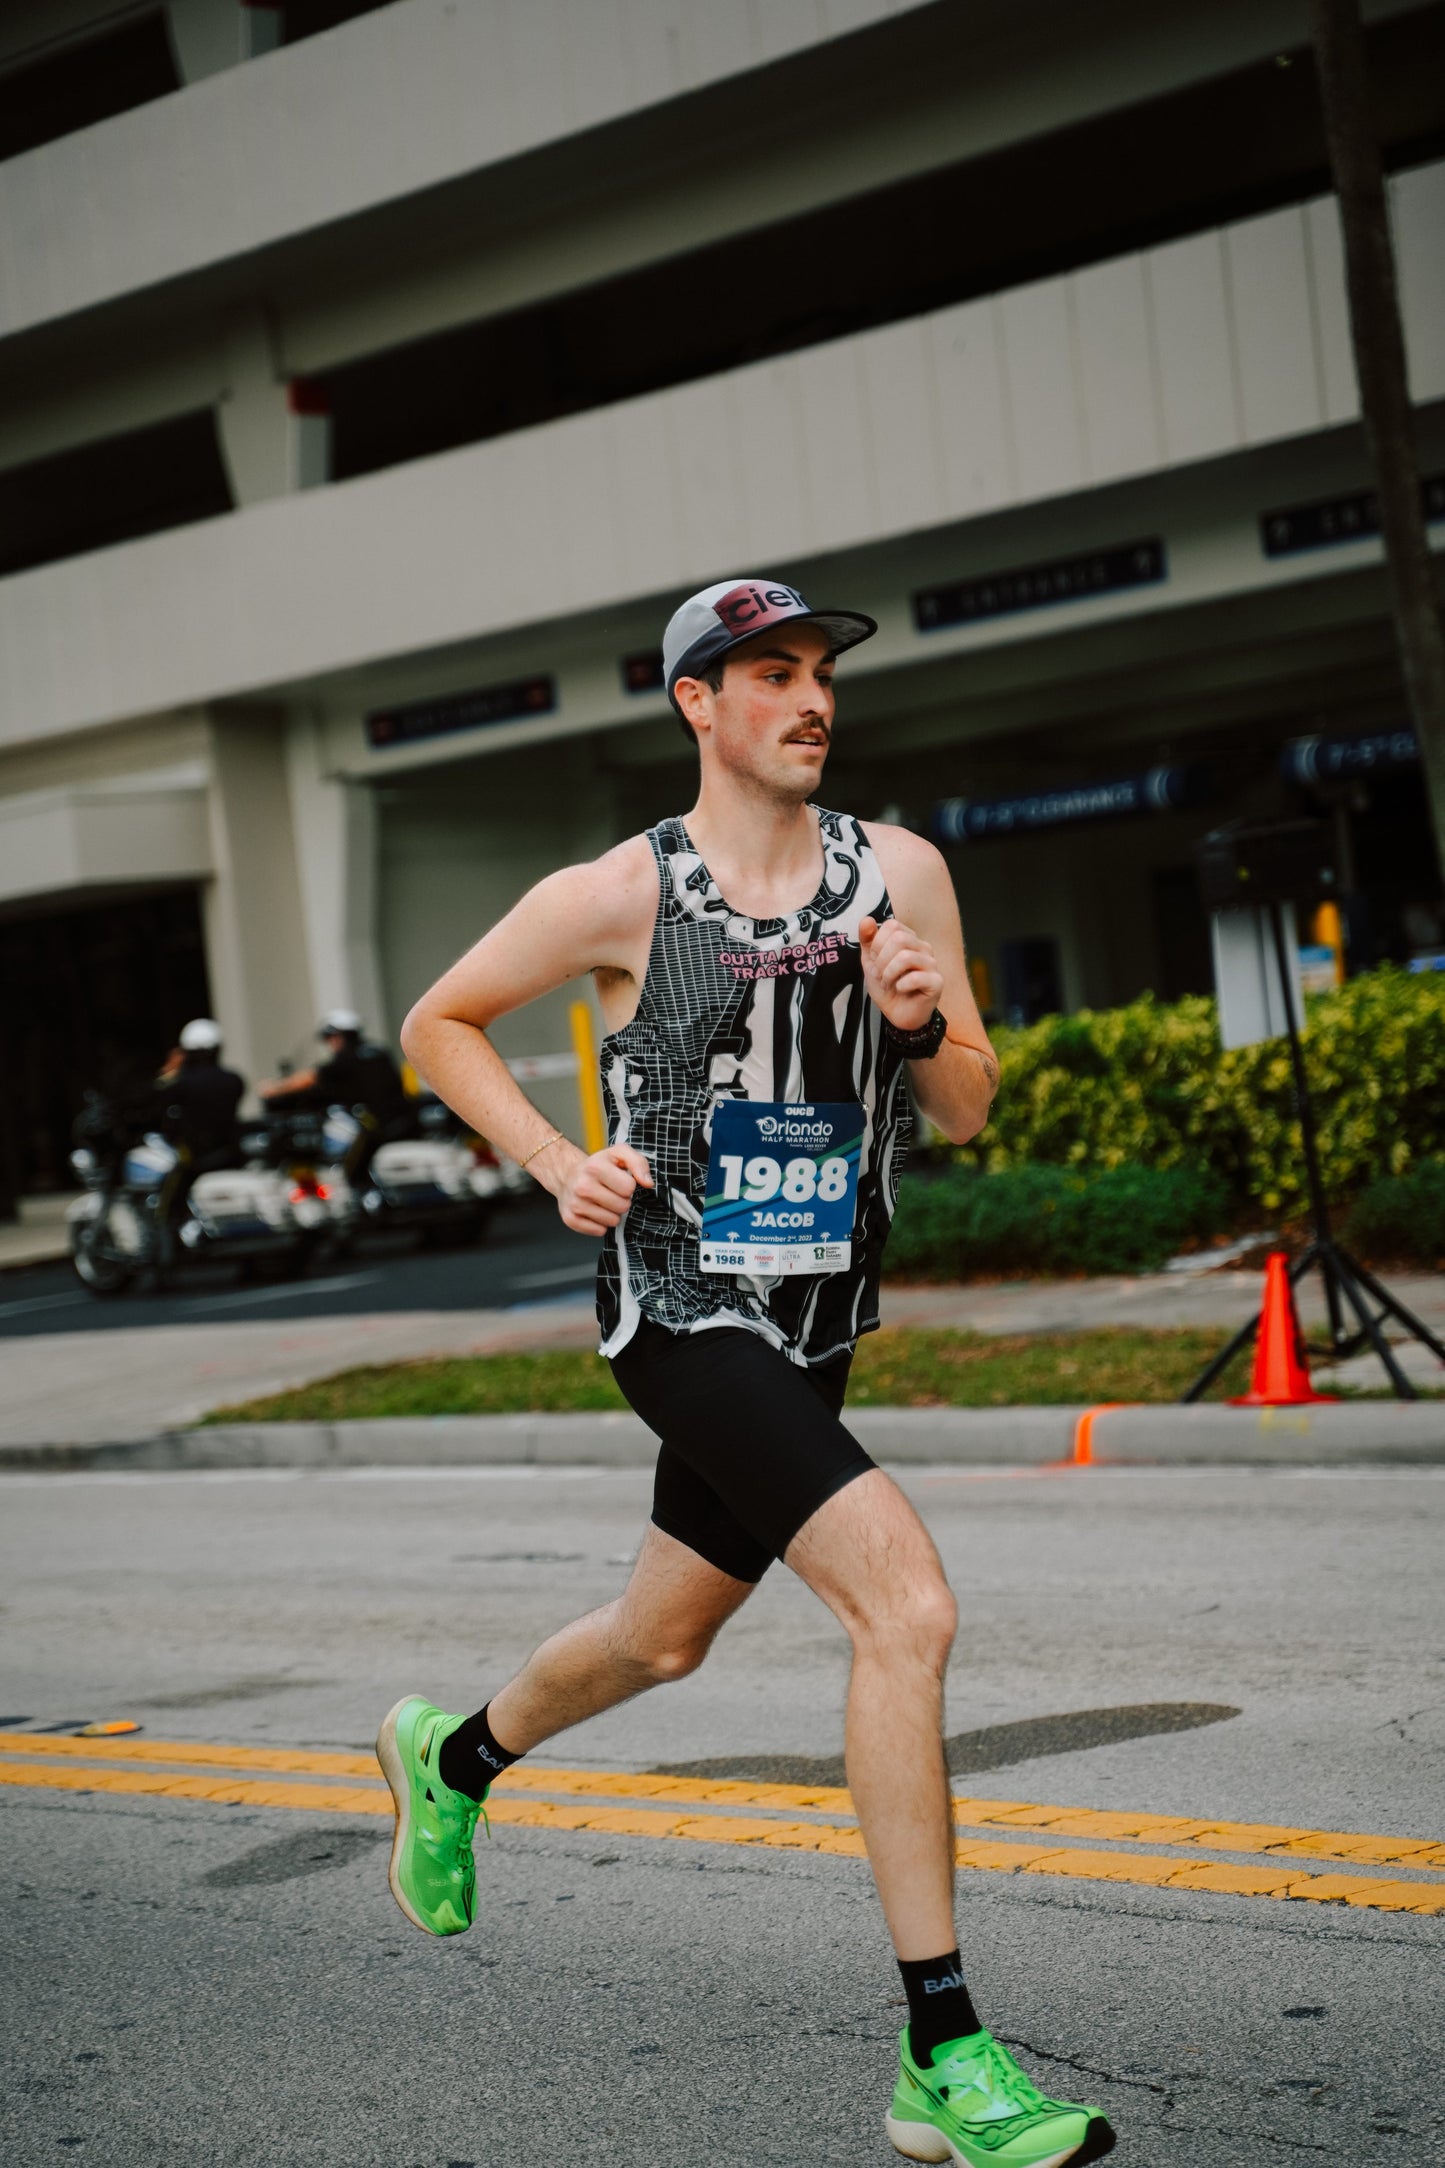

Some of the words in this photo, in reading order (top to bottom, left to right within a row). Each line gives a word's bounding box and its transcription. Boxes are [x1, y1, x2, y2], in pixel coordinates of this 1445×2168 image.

[719, 950, 778, 966] OUTTA
[781, 933, 849, 961] POCKET
[732, 963, 790, 980] TRACK
[794, 950, 840, 973] CLUB
[785, 1106, 806, 1116] OUC
[758, 1116, 834, 1136] Orlando
[786, 1136, 830, 1144] MARATHON
[719, 1154, 849, 1203] 1988
[751, 1212, 815, 1228] JACOB
[749, 1234, 786, 1243] December
[798, 1234, 813, 1242] 2023
[715, 1255, 745, 1265] 1988
